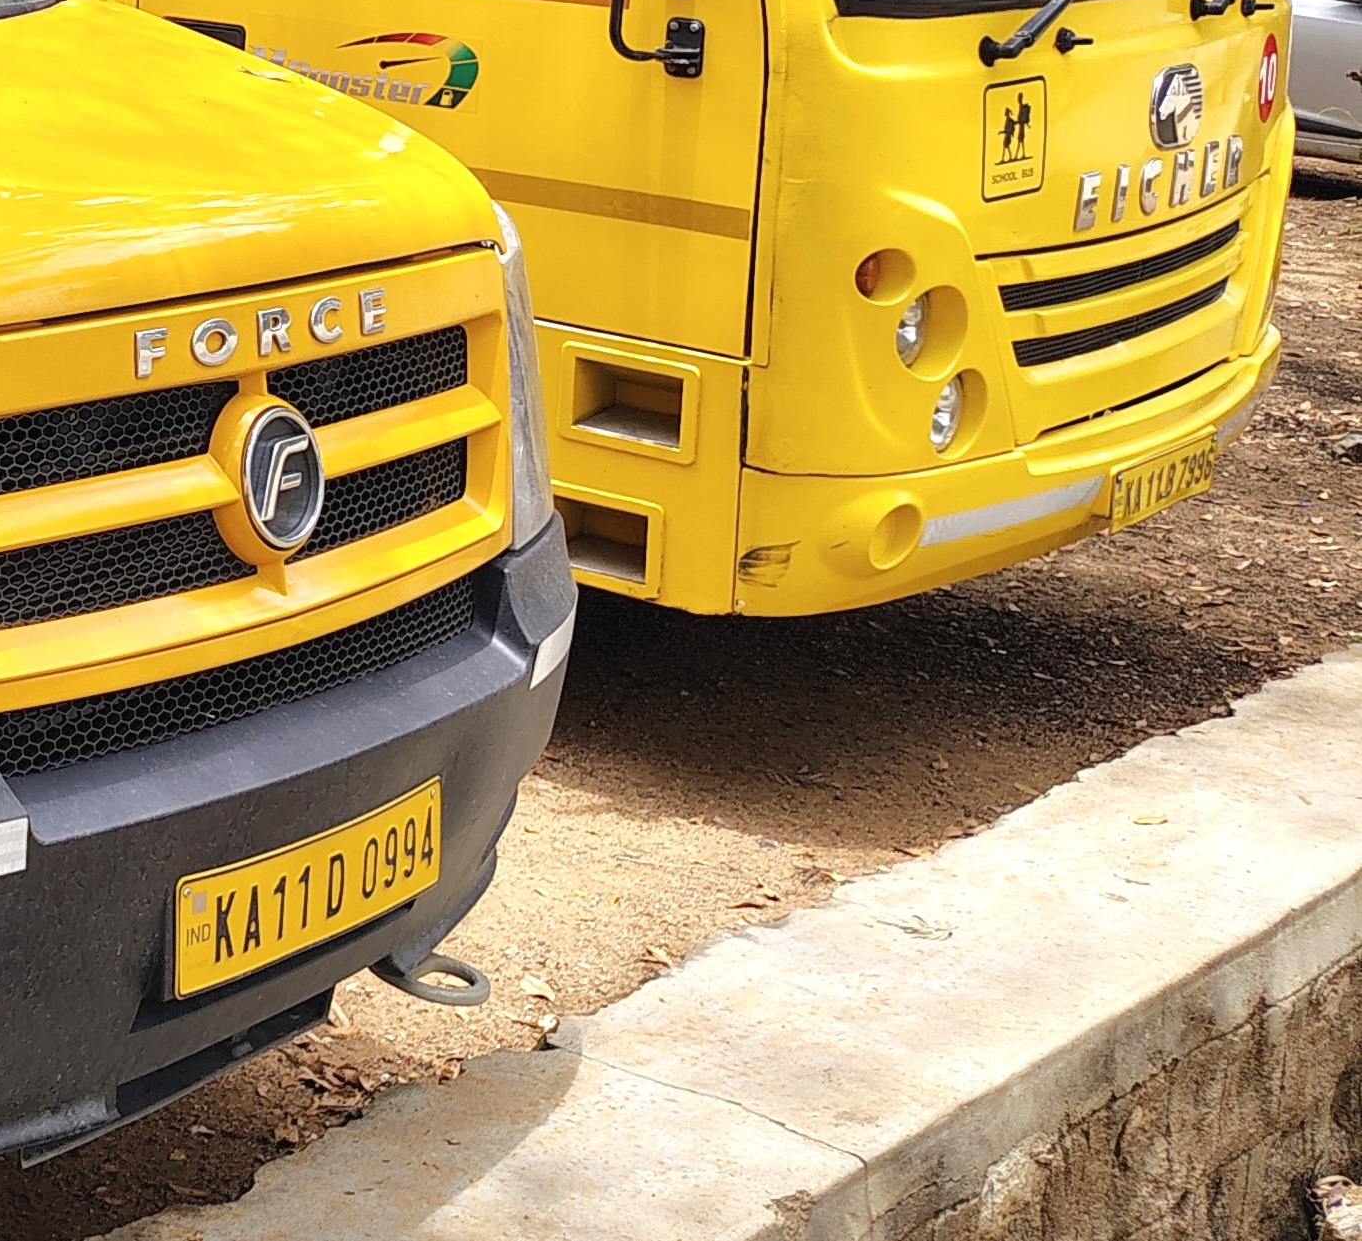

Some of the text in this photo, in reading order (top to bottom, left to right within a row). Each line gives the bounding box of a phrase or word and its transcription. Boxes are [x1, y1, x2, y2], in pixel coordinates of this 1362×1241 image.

[1260, 53, 1277, 105] 10
[991, 167, 1035, 185] SCHOOL BUS
[1073, 134, 1244, 232] EICHER
[134, 286, 388, 378] FORCE
[325, 852, 346, 920] D
[361, 803, 434, 900] 0994
[185, 923, 211, 948] IND
